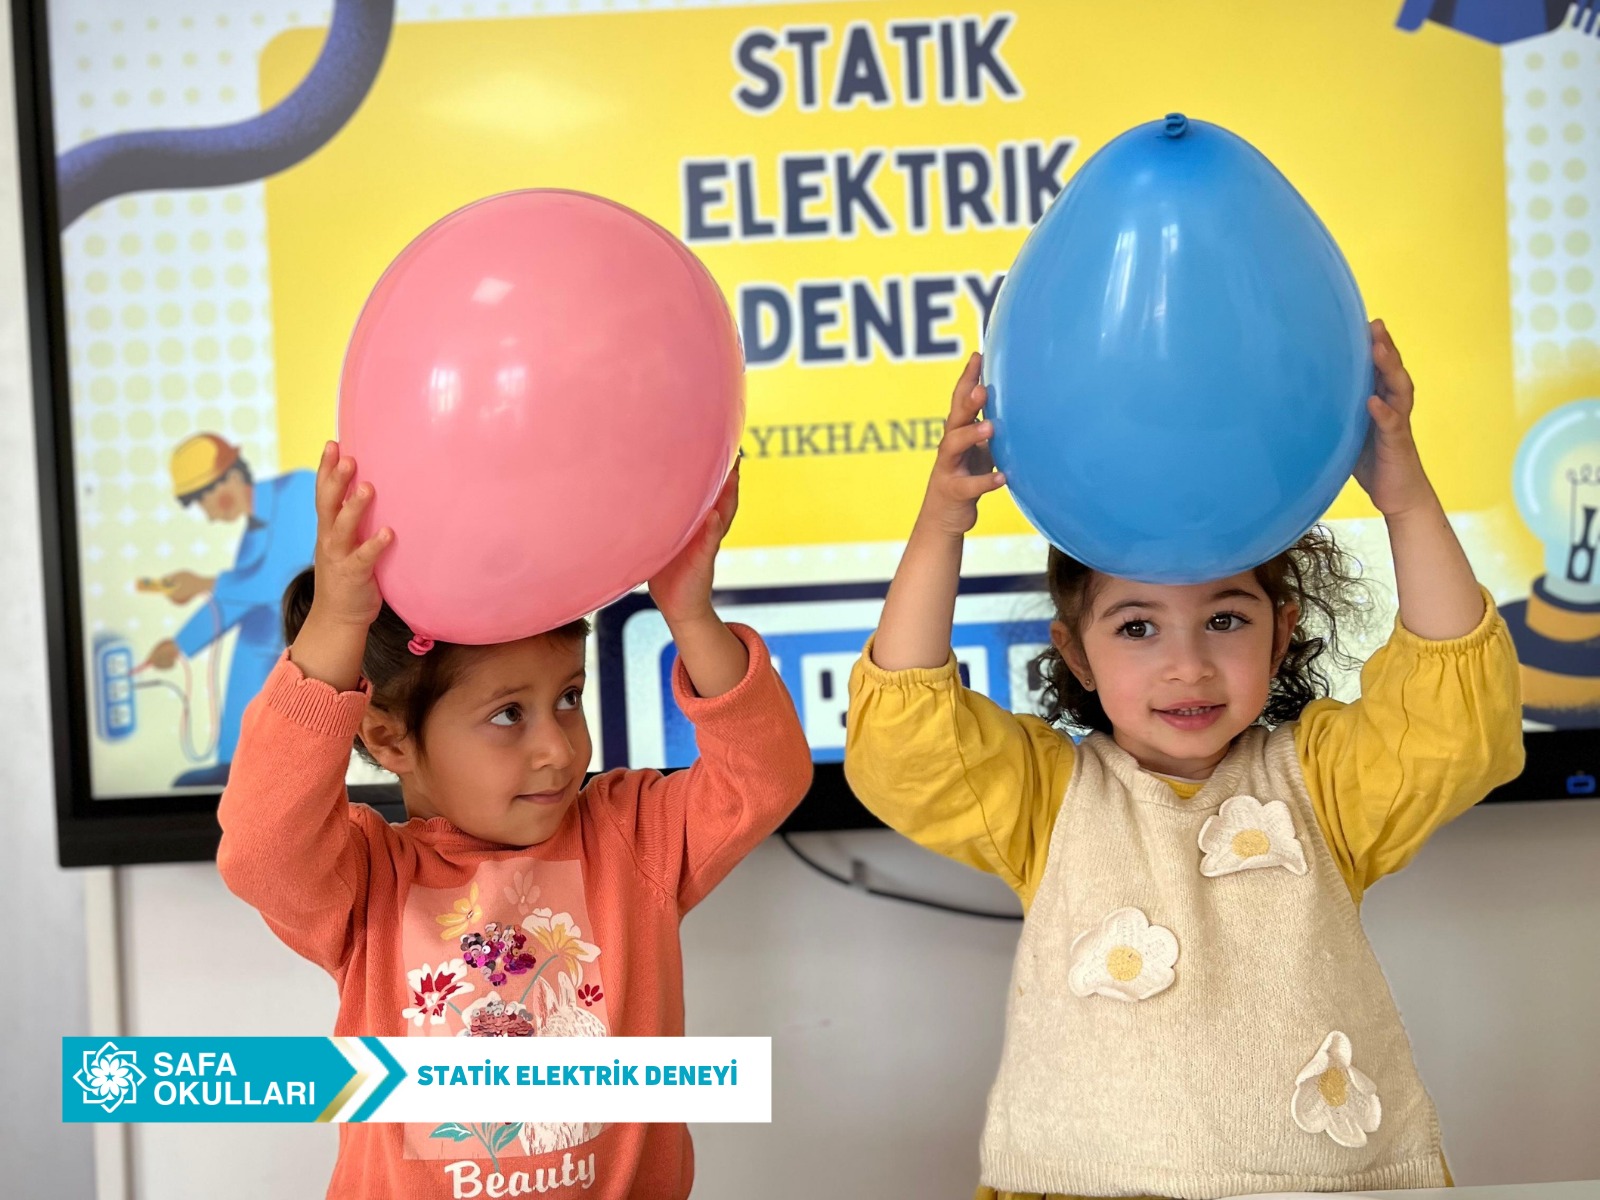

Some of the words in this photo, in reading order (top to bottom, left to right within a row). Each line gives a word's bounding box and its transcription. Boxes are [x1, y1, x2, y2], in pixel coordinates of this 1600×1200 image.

[736, 16, 1019, 110] STATIK
[685, 141, 1072, 240] ELEKTRIK
[444, 1152, 596, 1200] Beauty
